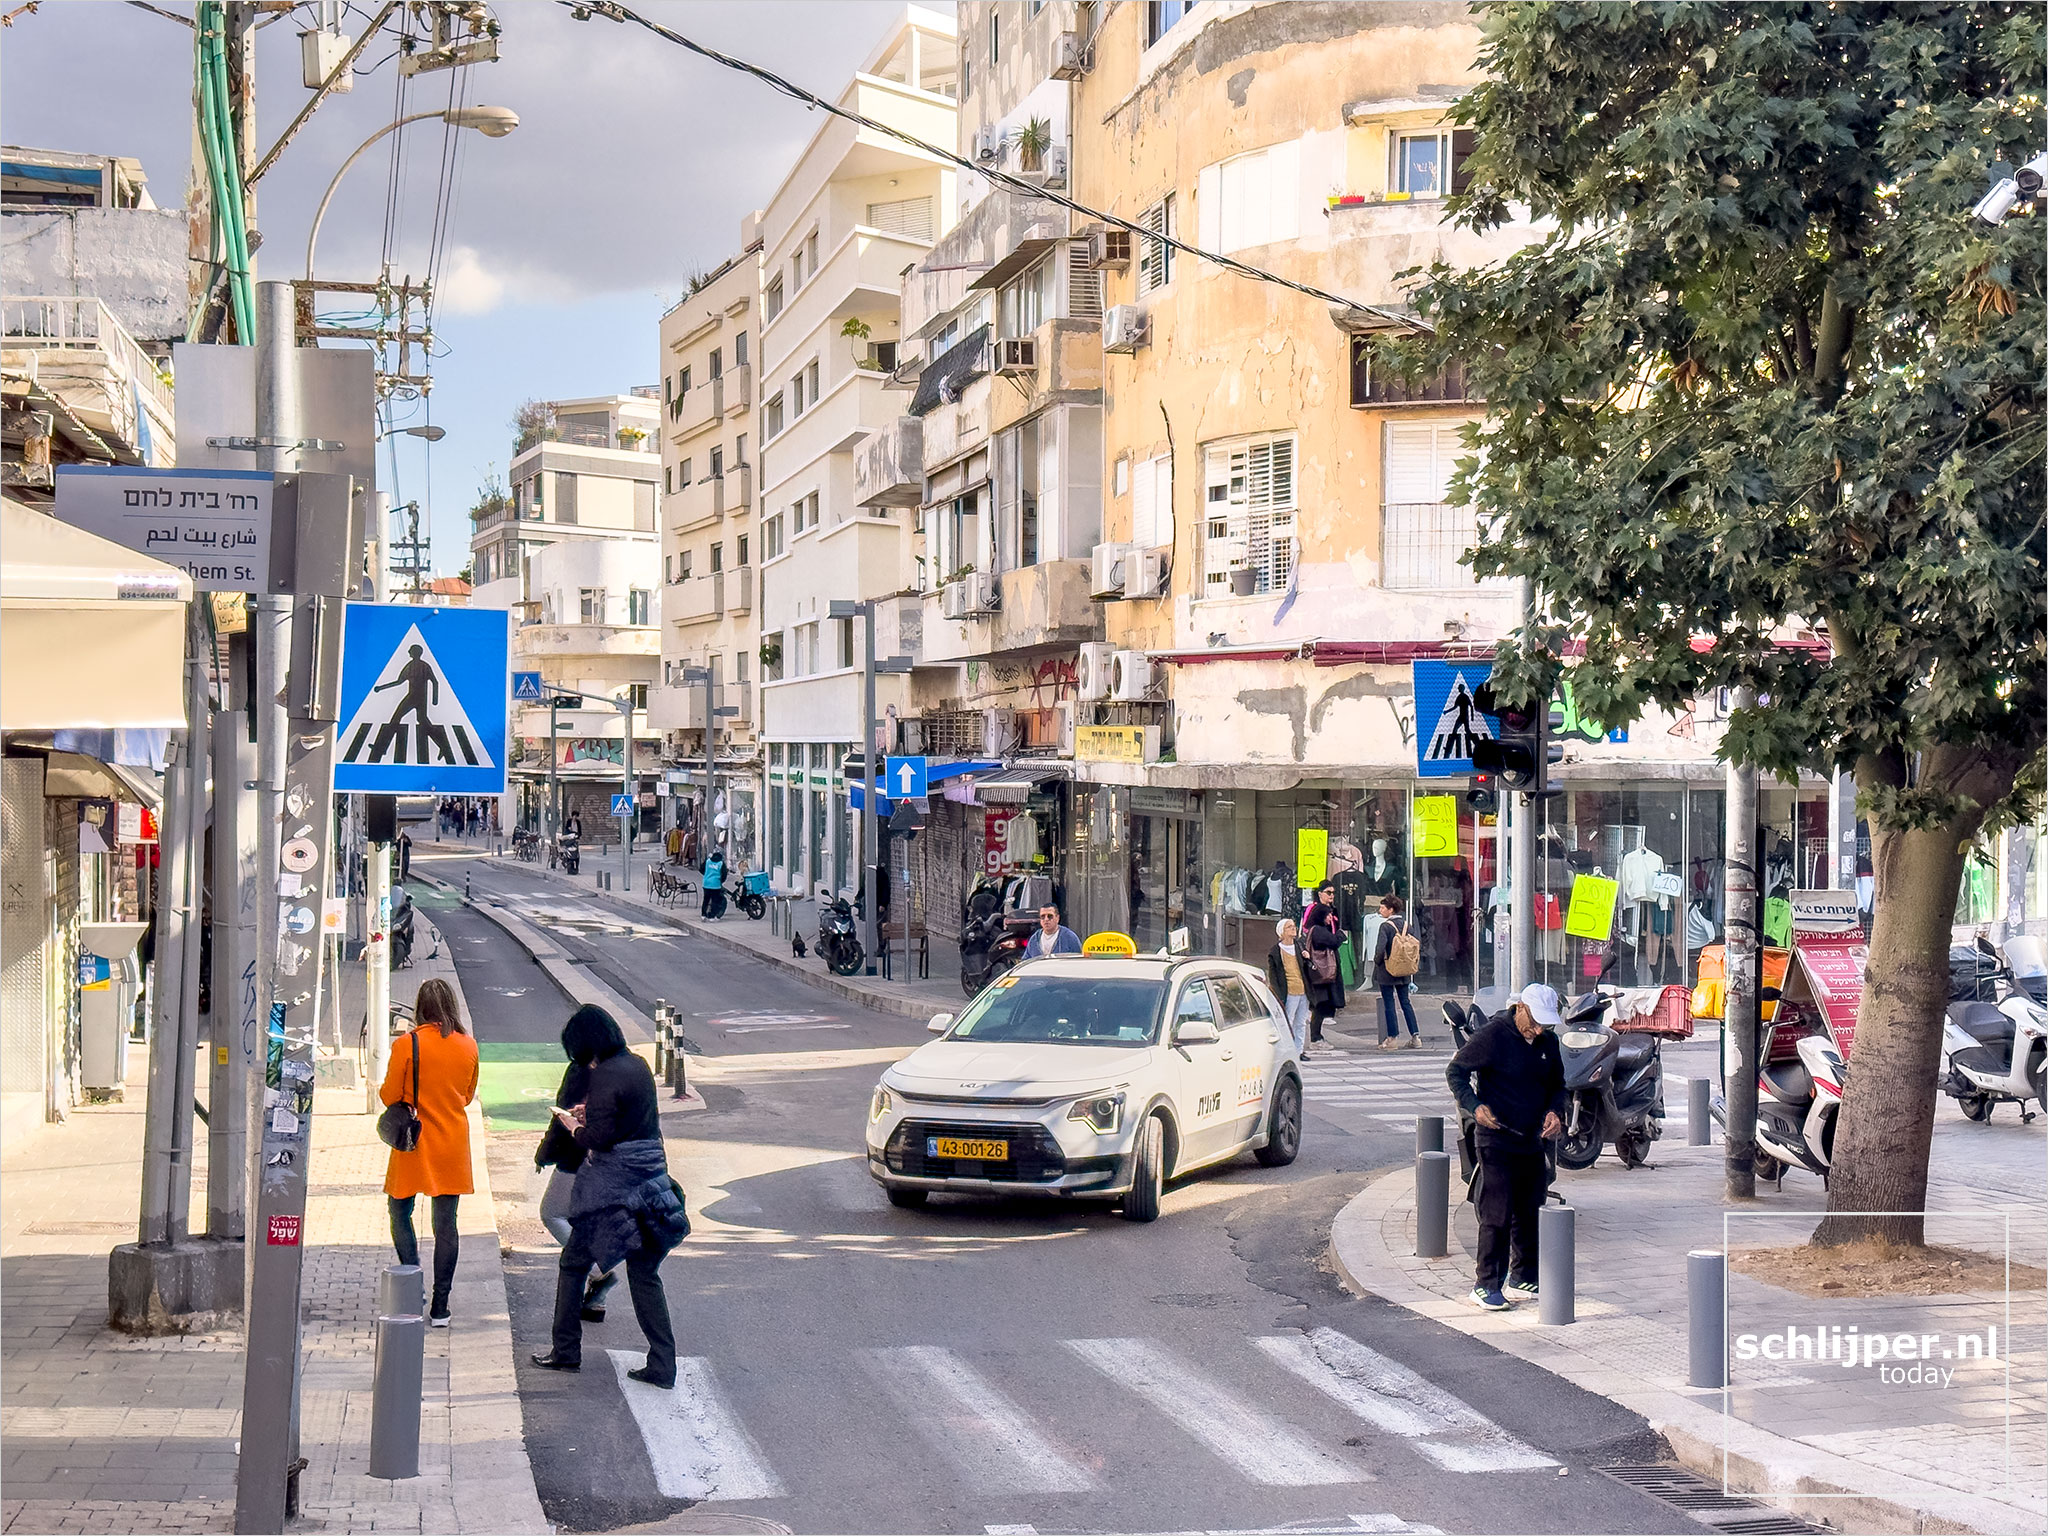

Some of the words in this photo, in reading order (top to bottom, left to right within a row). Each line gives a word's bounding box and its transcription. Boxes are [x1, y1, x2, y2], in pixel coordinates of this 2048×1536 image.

[123, 487, 172, 507] לחם
[179, 491, 220, 509] בית
[146, 526, 178, 548] لحم
[184, 528, 217, 548] بيت
[221, 528, 257, 549] شارع
[233, 566, 256, 581] St.
[1303, 853, 1318, 883] 5
[1574, 899, 1597, 932] 5
[1814, 905, 1856, 915] שרותים
